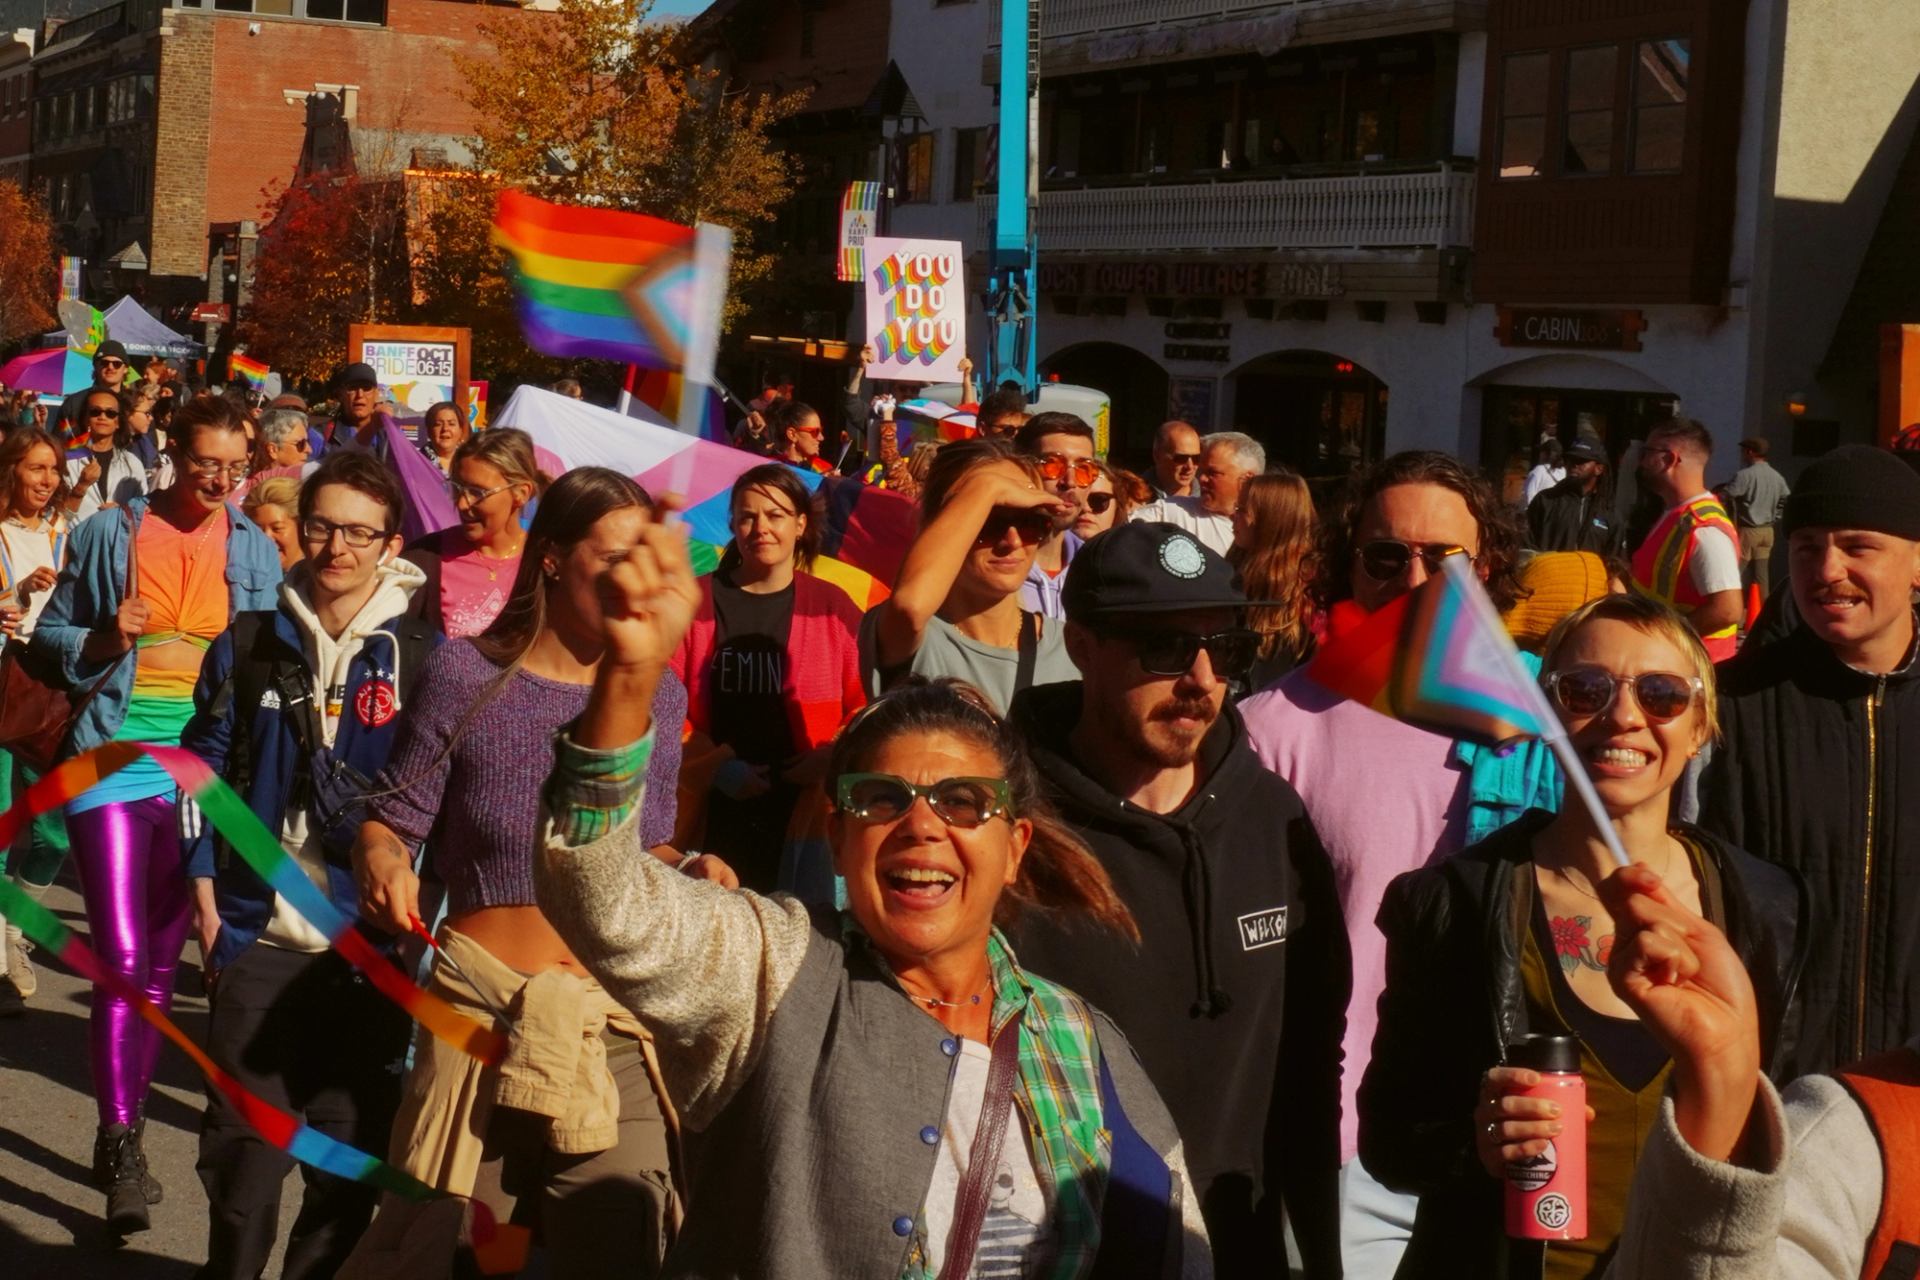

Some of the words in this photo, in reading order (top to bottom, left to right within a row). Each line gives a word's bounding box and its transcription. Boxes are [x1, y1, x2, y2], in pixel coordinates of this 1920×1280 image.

[848, 236, 865, 246] PRID
[894, 252, 955, 280] YOU
[1041, 262, 1079, 291] OCK
[905, 284, 945, 311] DO
[896, 316, 958, 345] YOU
[1524, 316, 1581, 342] CABIN
[365, 345, 415, 357] BANFF
[416, 347, 452, 361] OCT
[364, 357, 416, 376] PRIDE
[416, 359, 452, 376] 06-15
[260, 698, 281, 710] adida
